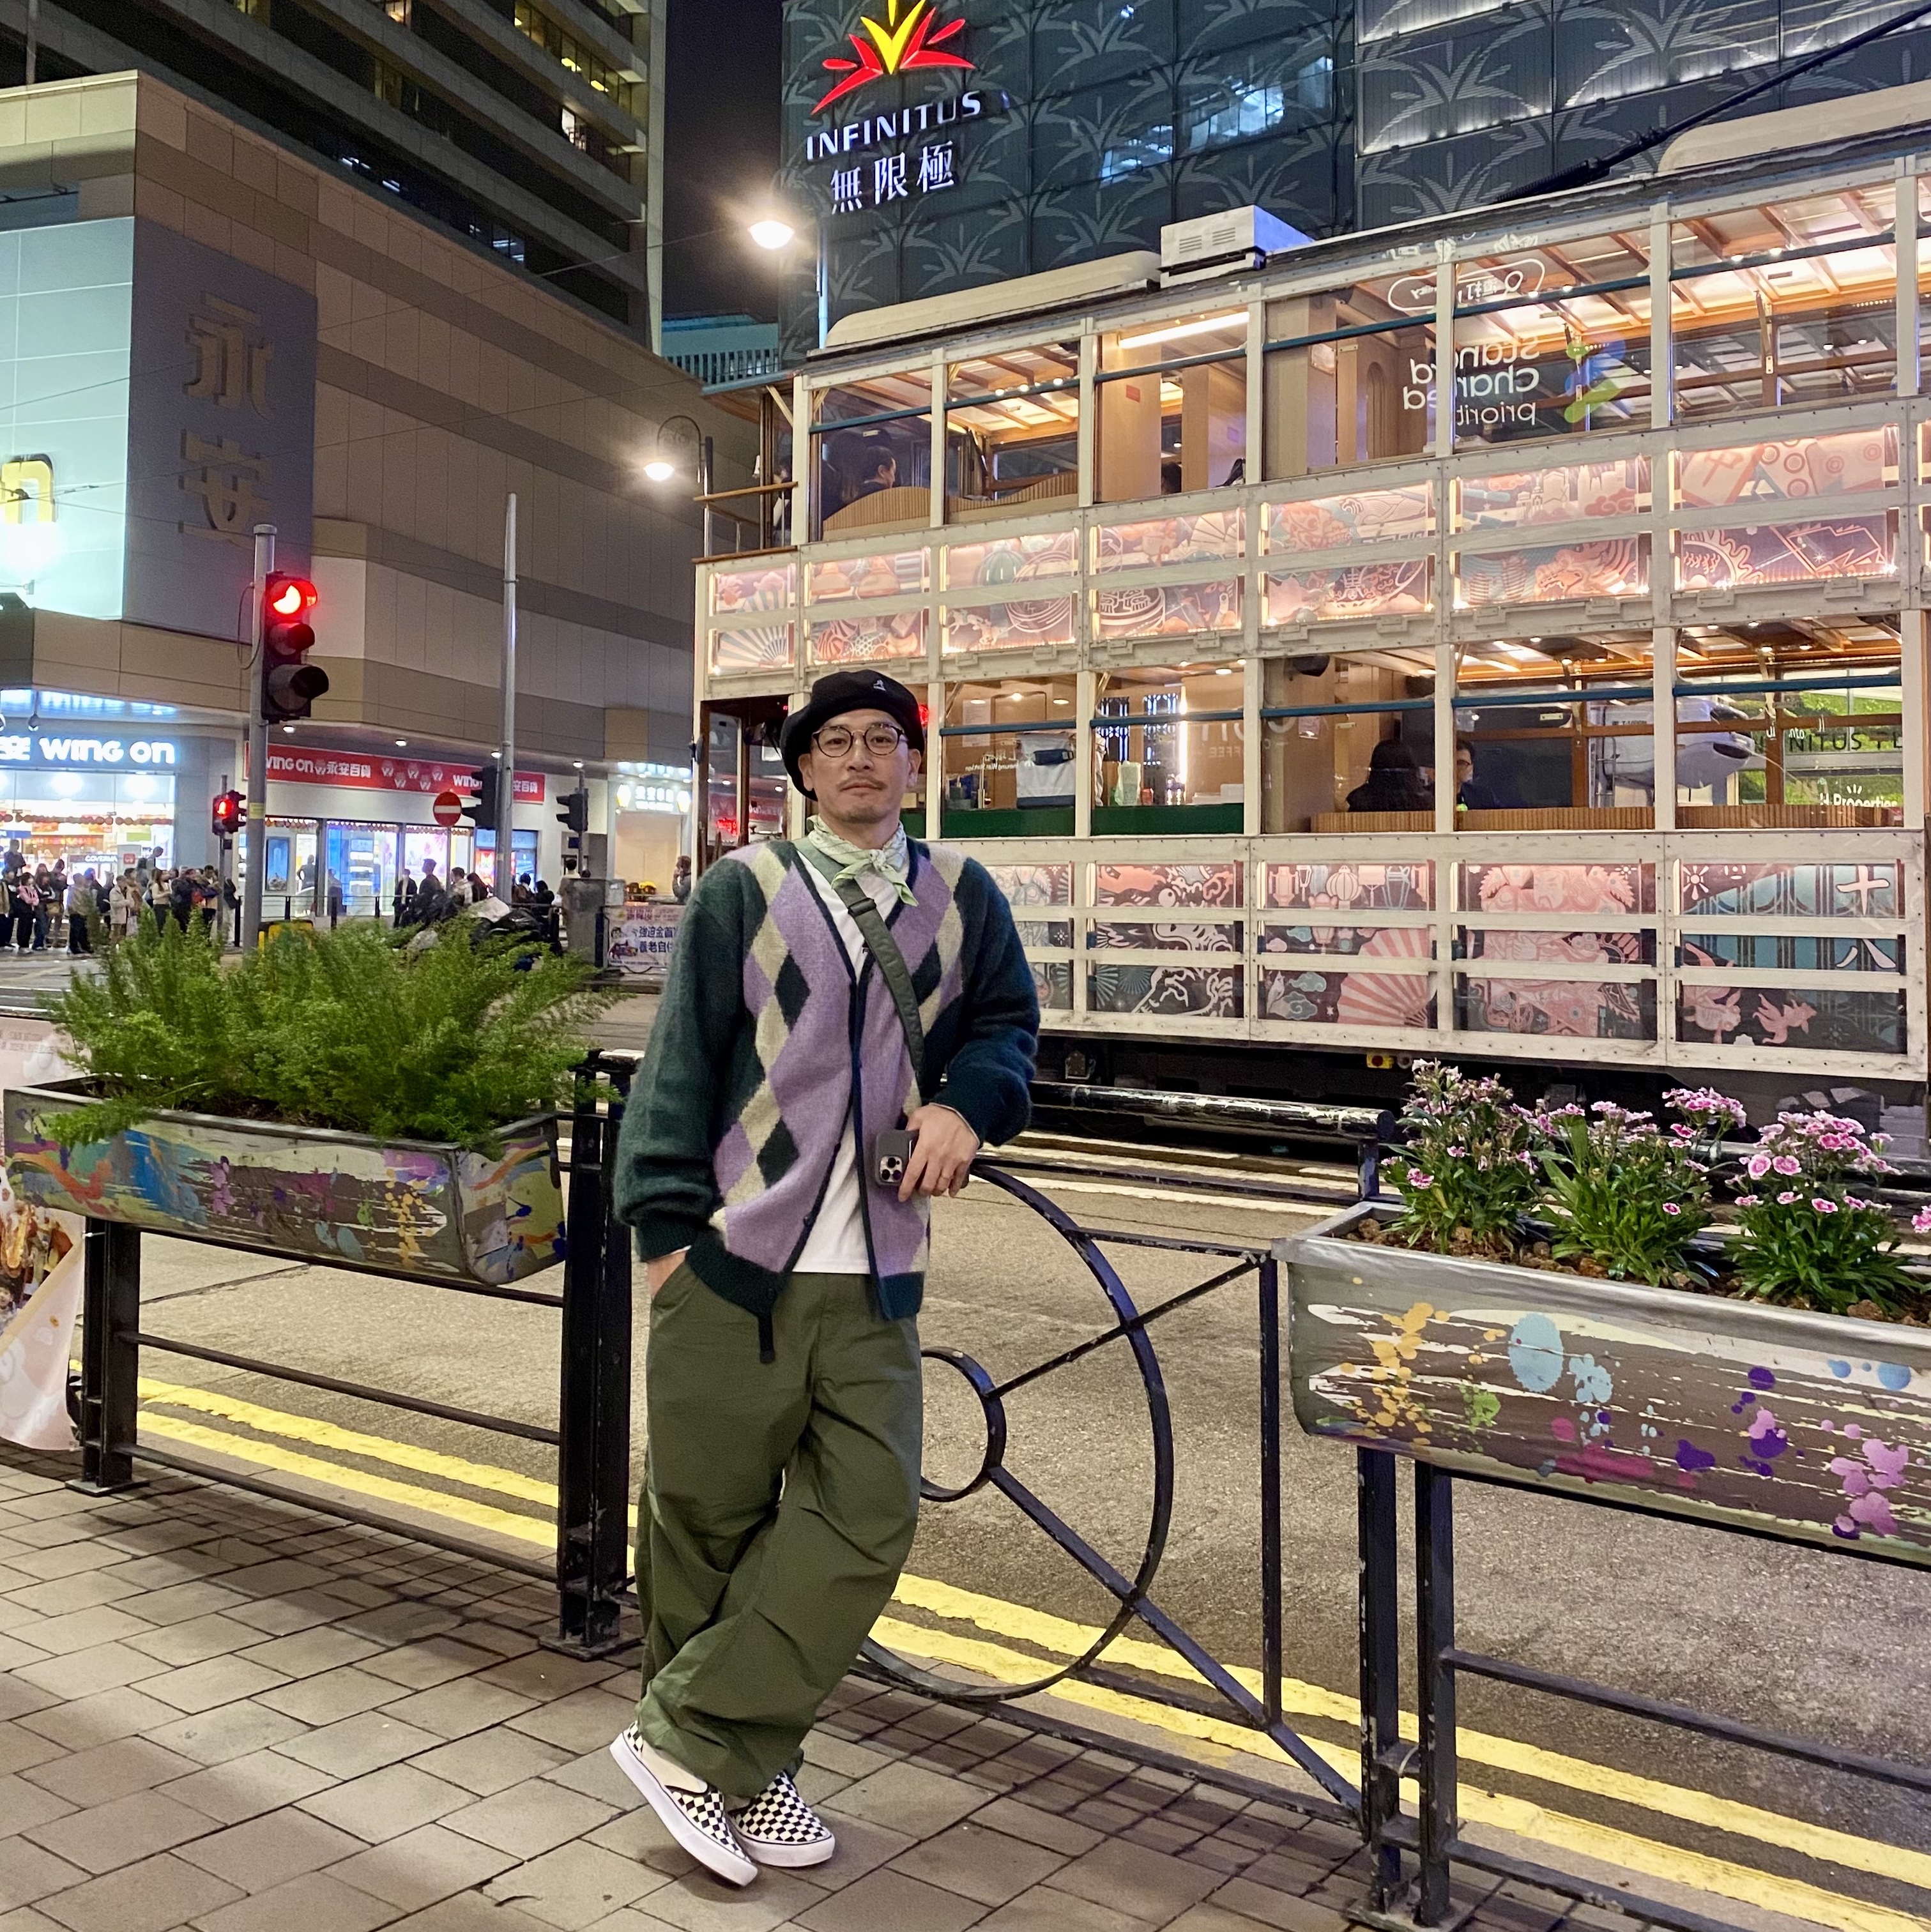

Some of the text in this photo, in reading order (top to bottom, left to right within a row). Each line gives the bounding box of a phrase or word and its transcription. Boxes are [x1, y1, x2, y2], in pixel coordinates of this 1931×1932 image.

[806, 91, 981, 161] INFINITUS
[830, 141, 955, 215] 無限極
